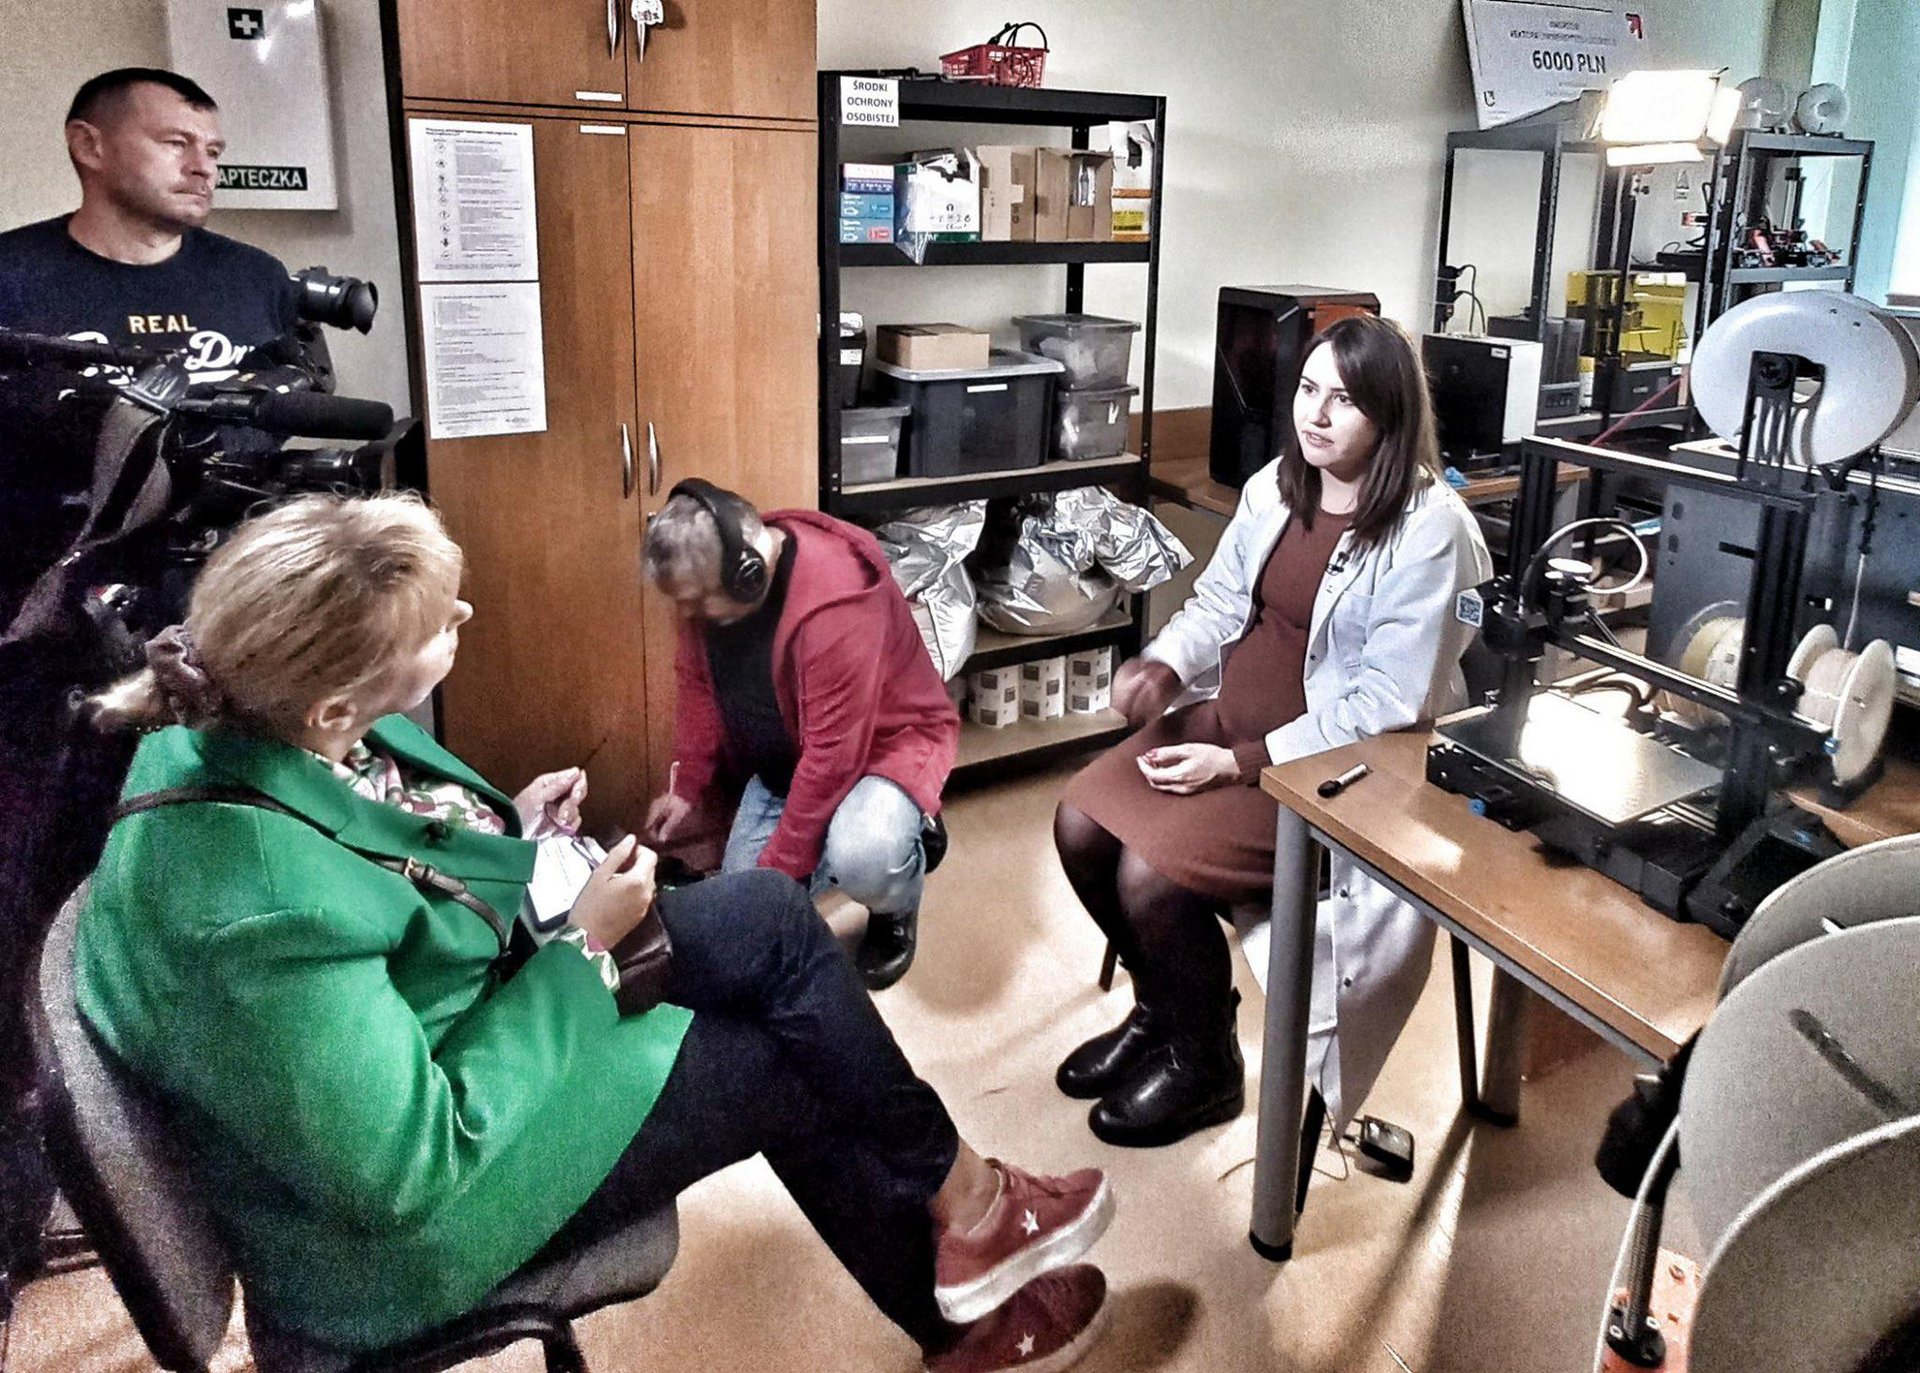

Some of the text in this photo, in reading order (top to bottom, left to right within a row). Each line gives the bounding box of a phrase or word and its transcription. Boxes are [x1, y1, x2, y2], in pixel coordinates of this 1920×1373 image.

[1532, 50, 1606, 74] 6000 PLN
[853, 80, 888, 92] ŚRODKI
[847, 97, 893, 108] OCHRONY
[846, 112, 895, 123] OSOBISTEJ
[217, 168, 304, 188] APTECZKA
[128, 314, 198, 334] REAL
